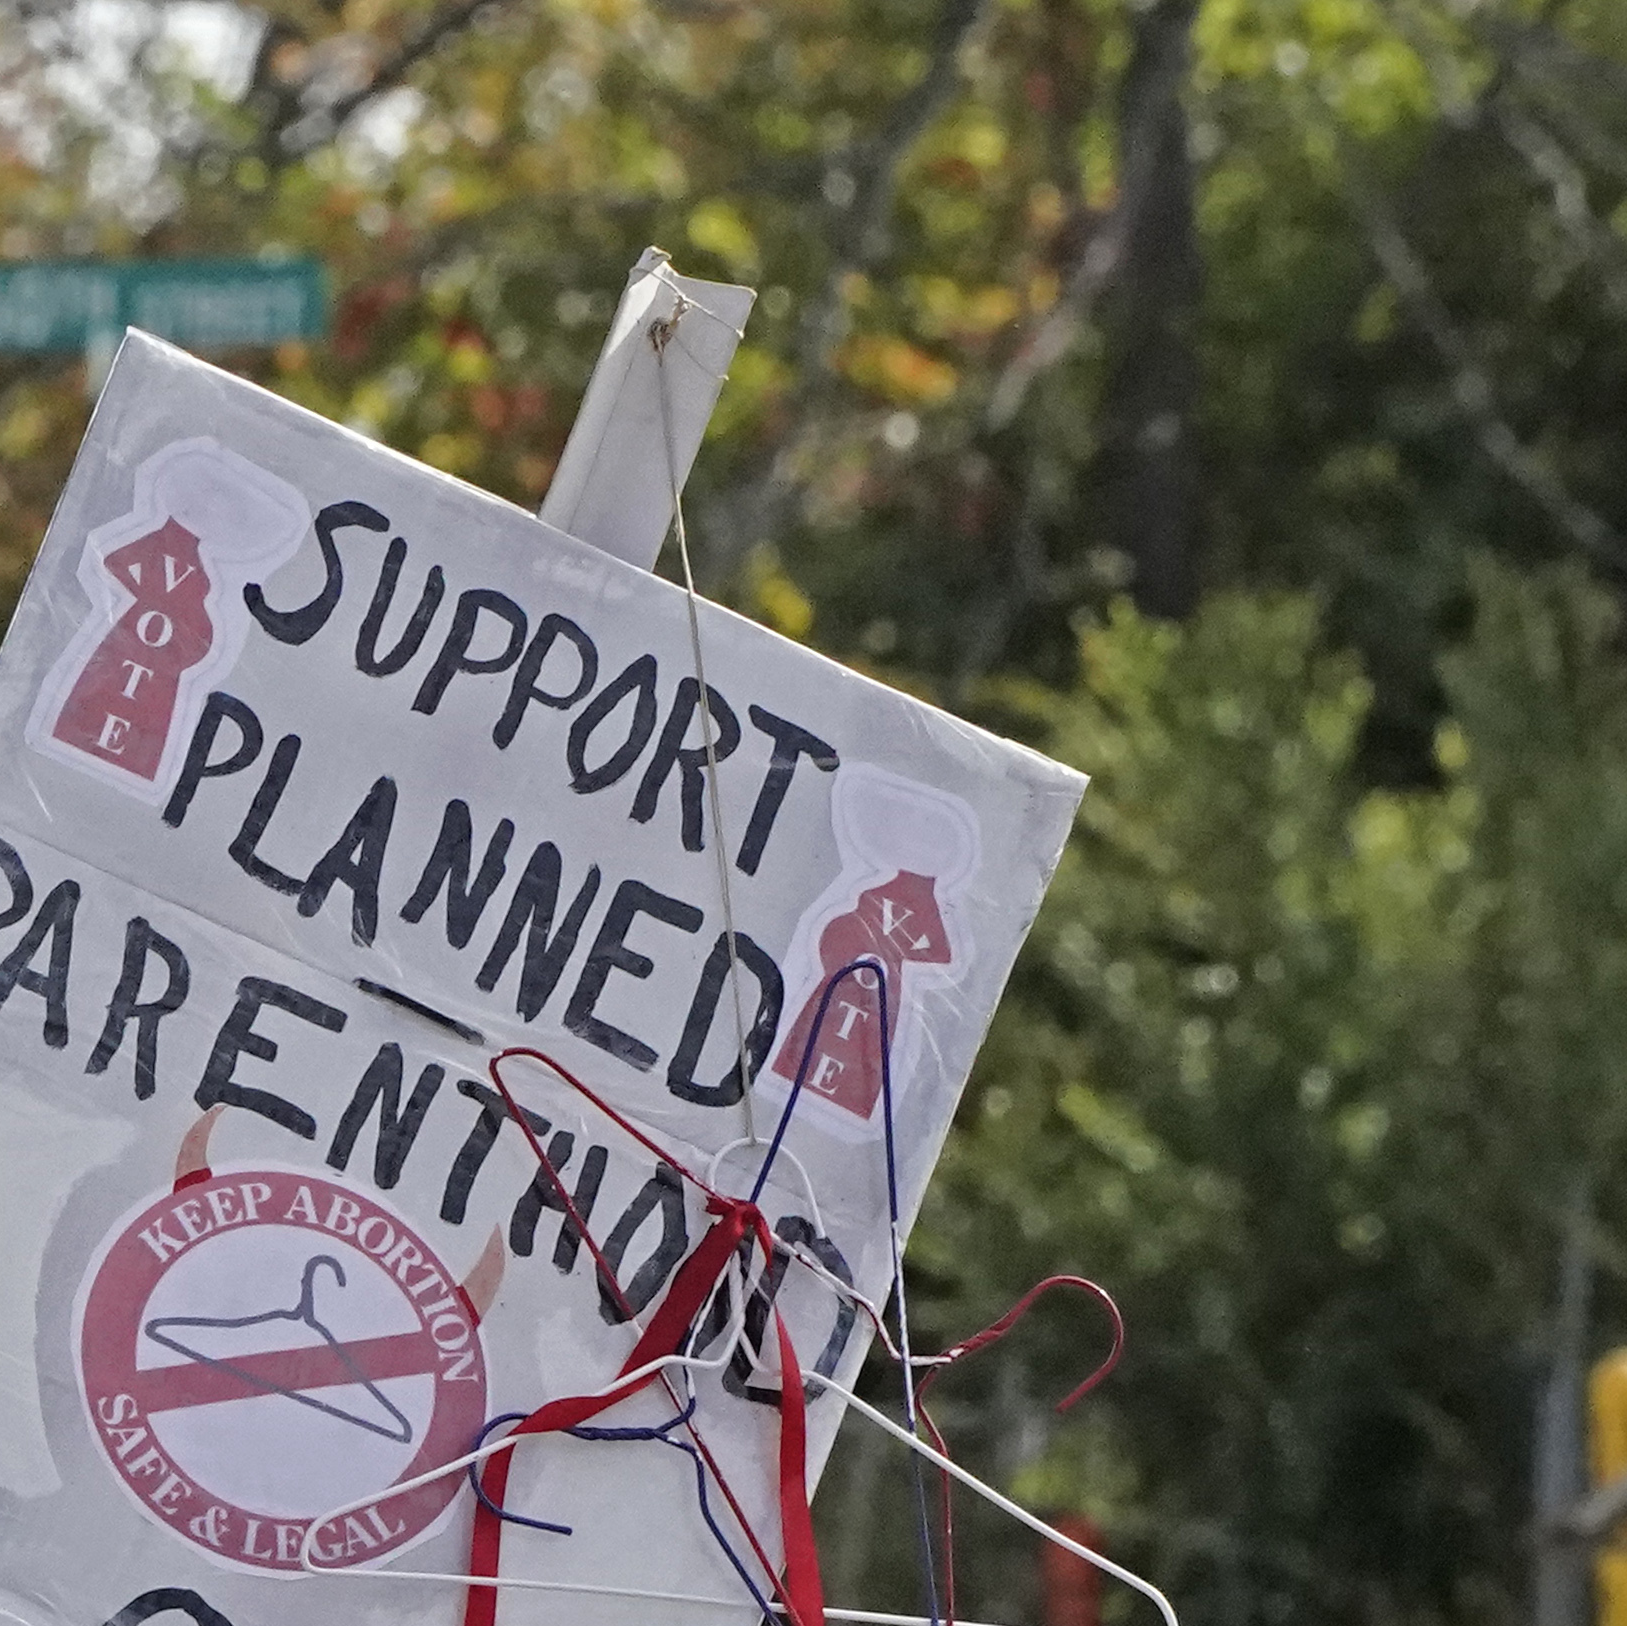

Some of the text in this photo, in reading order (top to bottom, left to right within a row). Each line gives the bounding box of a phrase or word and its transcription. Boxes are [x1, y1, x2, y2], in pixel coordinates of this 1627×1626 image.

[97, 556, 196, 755] VOTE
[243, 501, 840, 877] SUPPORT
[162, 691, 784, 1107] PLANNED
[137, 1181, 478, 1384] KEEP ABORTION
[97, 1393, 407, 1563] SAFE & LEGAL
